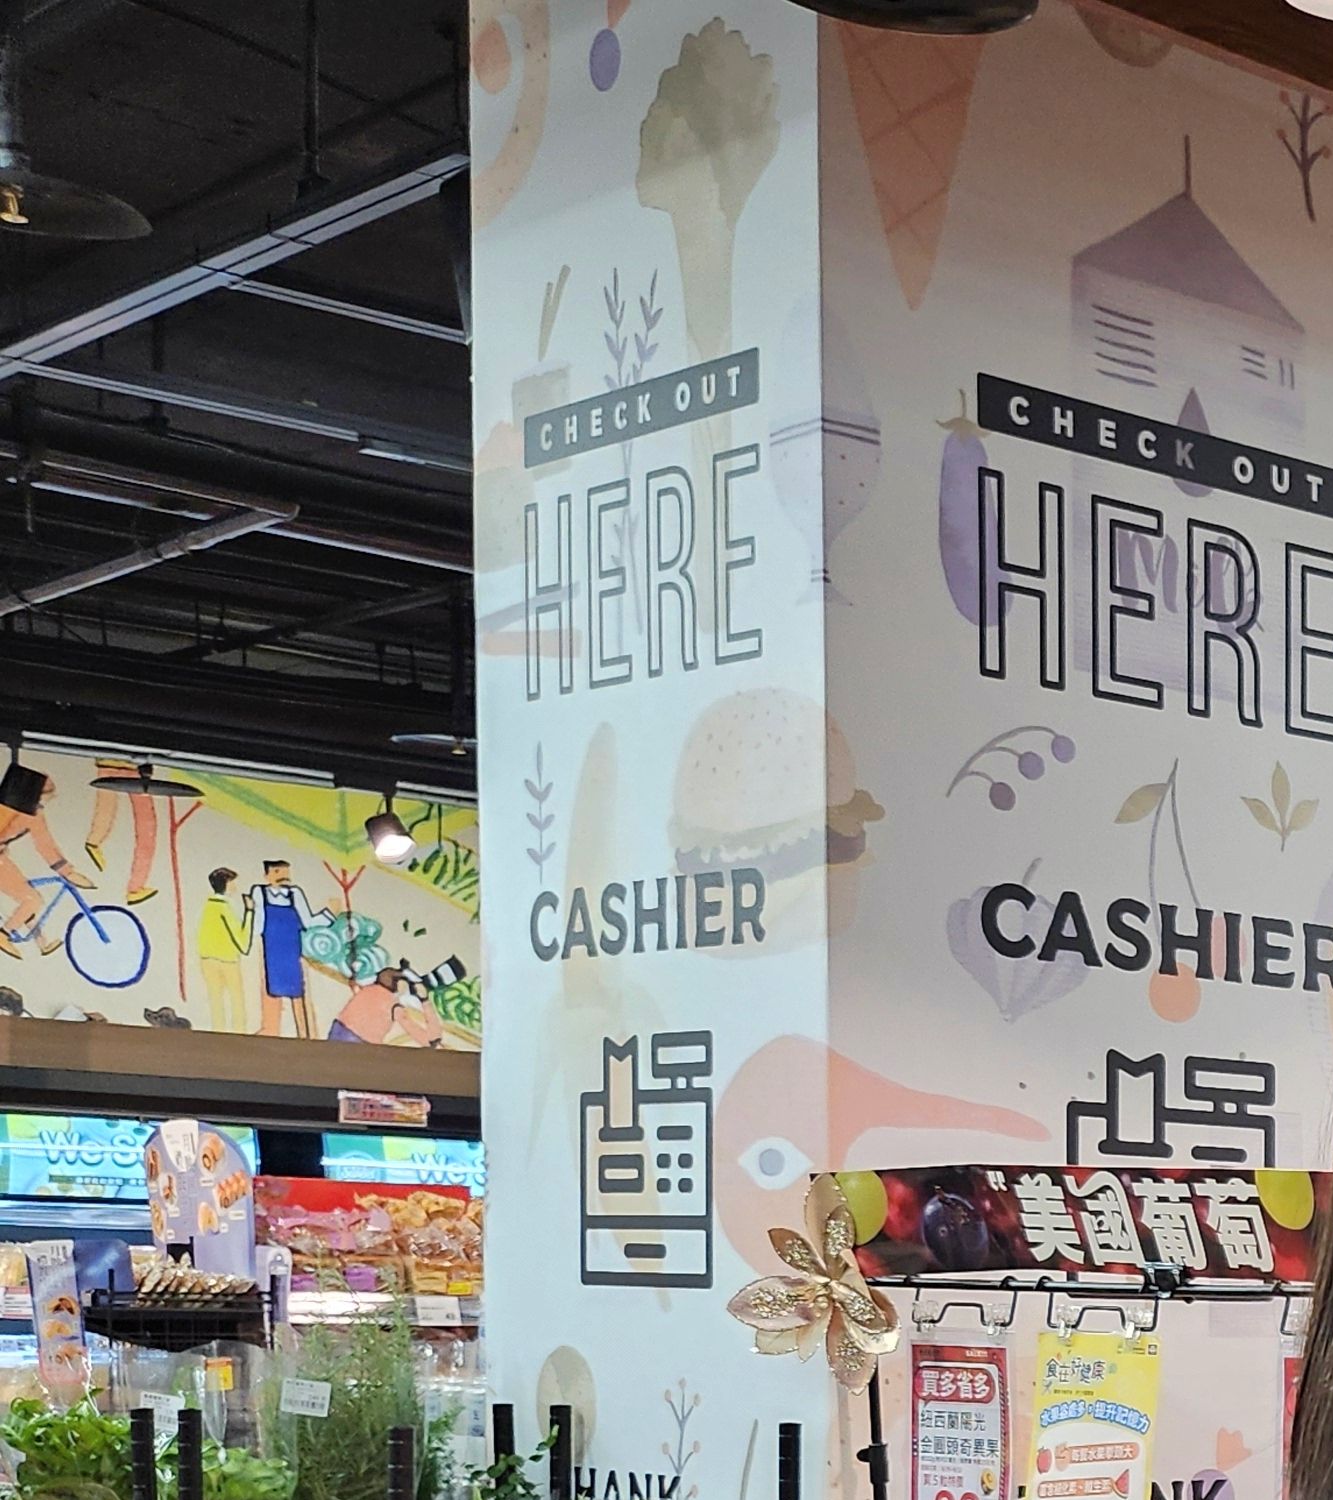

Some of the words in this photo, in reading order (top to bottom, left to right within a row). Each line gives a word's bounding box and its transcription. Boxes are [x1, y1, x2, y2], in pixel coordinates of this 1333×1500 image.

[539, 390, 650, 453] CHECK
[674, 365, 746, 413] OUT
[1009, 395, 1197, 471] CHECK
[1233, 454, 1326, 505] OUT
[524, 443, 763, 701] HERE
[530, 866, 766, 962] CASHIER
[920, 1369, 990, 1400] 買多省多
